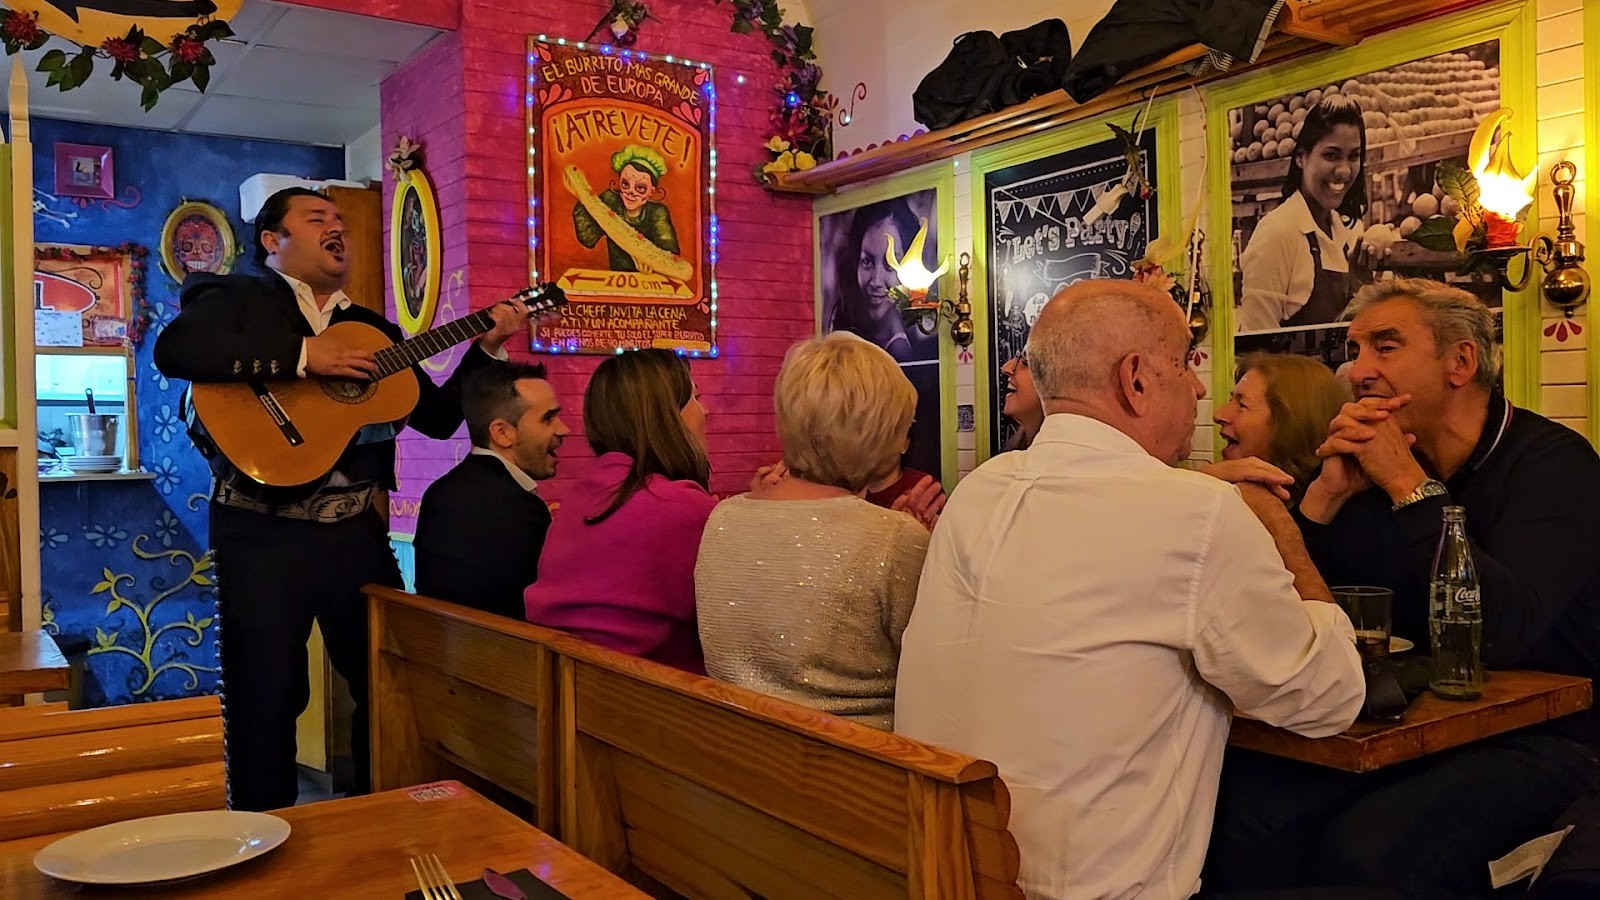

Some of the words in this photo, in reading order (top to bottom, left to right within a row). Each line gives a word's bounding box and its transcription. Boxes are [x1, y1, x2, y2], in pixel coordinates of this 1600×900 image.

[542, 63, 564, 82] EL
[565, 56, 623, 76] BURRITO
[626, 62, 652, 81] MAS
[654, 72, 701, 106] GRANDE
[581, 76, 605, 94] DE
[606, 75, 664, 106] EUROPA
[1012, 224, 1061, 264] Let's
[1064, 216, 1129, 249] Party
[605, 274, 639, 288] 100
[642, 279, 662, 290] cm
[561, 304, 575, 316] EL
[576, 304, 606, 317] CHEFF
[609, 305, 643, 318] INVITA
[645, 306, 657, 319] LA
[658, 307, 687, 320] CENA
[561, 317, 569, 327] A
[569, 318, 581, 328] TI
[583, 318, 590, 328] Y
[591, 319, 606, 329] UN
[607, 317, 680, 330] ACOMPAÑANTE
[540, 327, 550, 337] SI
[554, 328, 580, 337] PUEDES
[581, 329, 613, 338] COMERTE
[615, 330, 626, 339] TU
[626, 330, 642, 339] SOLO
[642, 330, 652, 339] EL
[653, 330, 673, 339] SUPER
[674, 331, 704, 341] BURRITO
[551, 338, 565, 346] EN
[566, 338, 594, 348] MENOS
[595, 339, 606, 348] DE
[607, 339, 618, 348] 40
